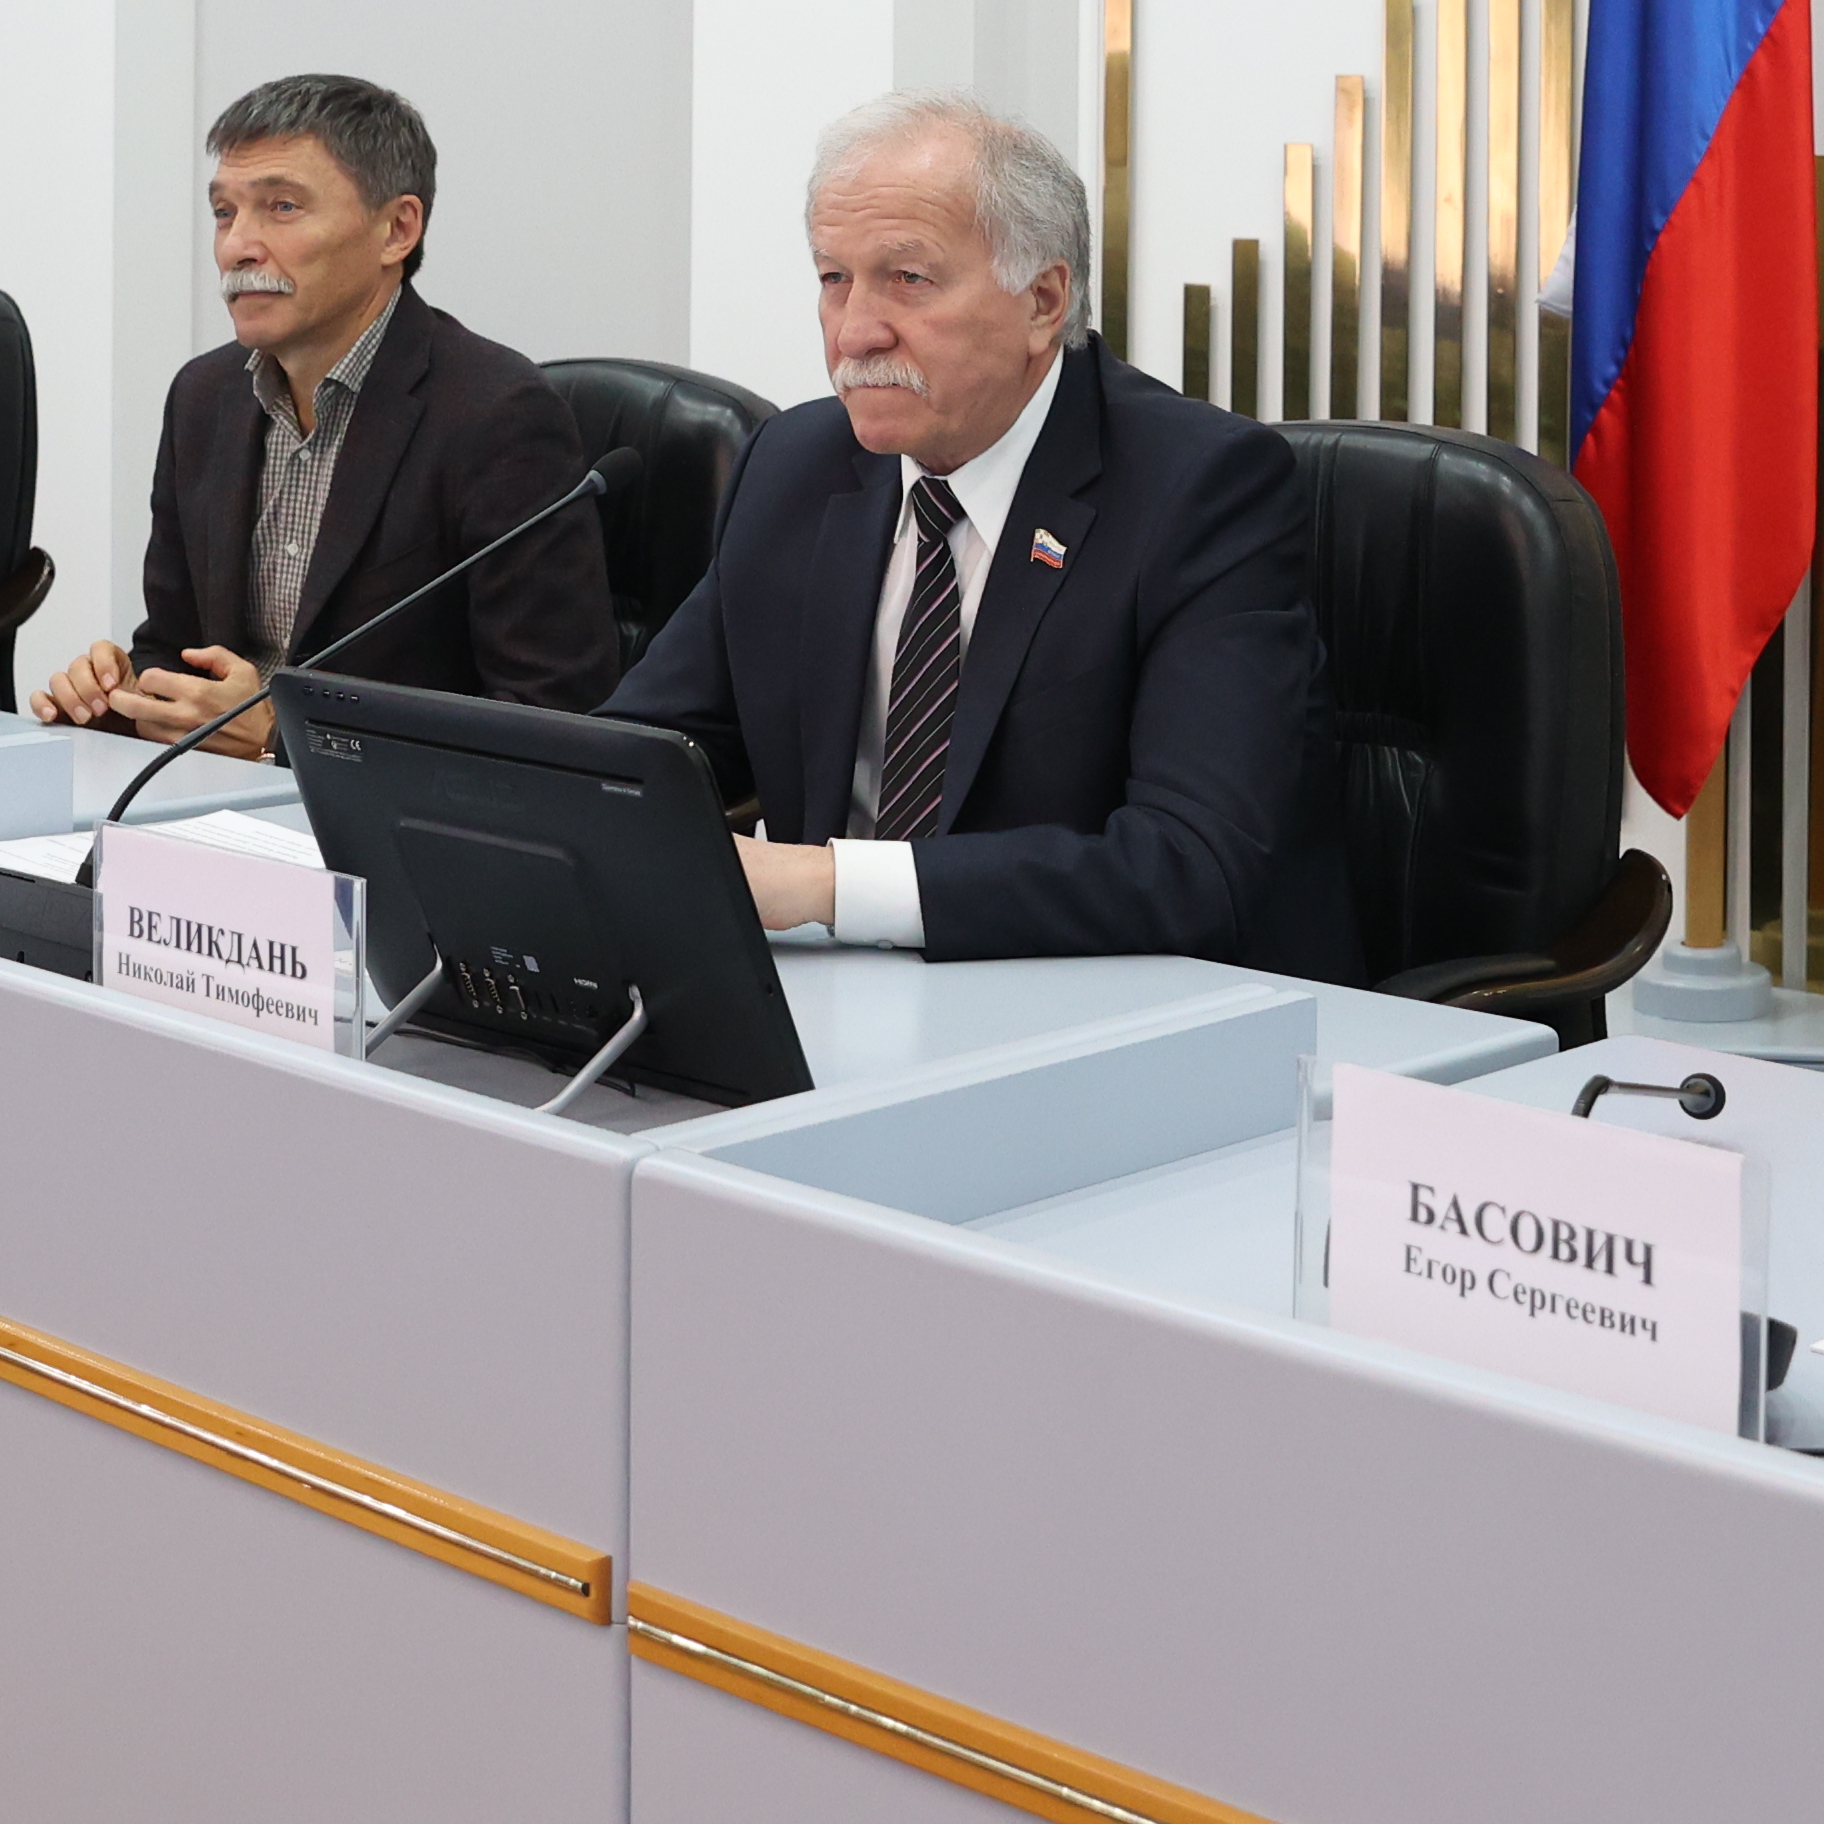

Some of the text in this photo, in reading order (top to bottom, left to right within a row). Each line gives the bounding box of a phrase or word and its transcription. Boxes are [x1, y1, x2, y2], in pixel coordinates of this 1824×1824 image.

[128, 905, 308, 980] ВЕЛИКДАНЬ
[117, 951, 319, 1026] Николай Тимофеевич
[1407, 1180, 1656, 1288] БАСОВИЧ
[1403, 1243, 1659, 1343] Егор Сергеевич
